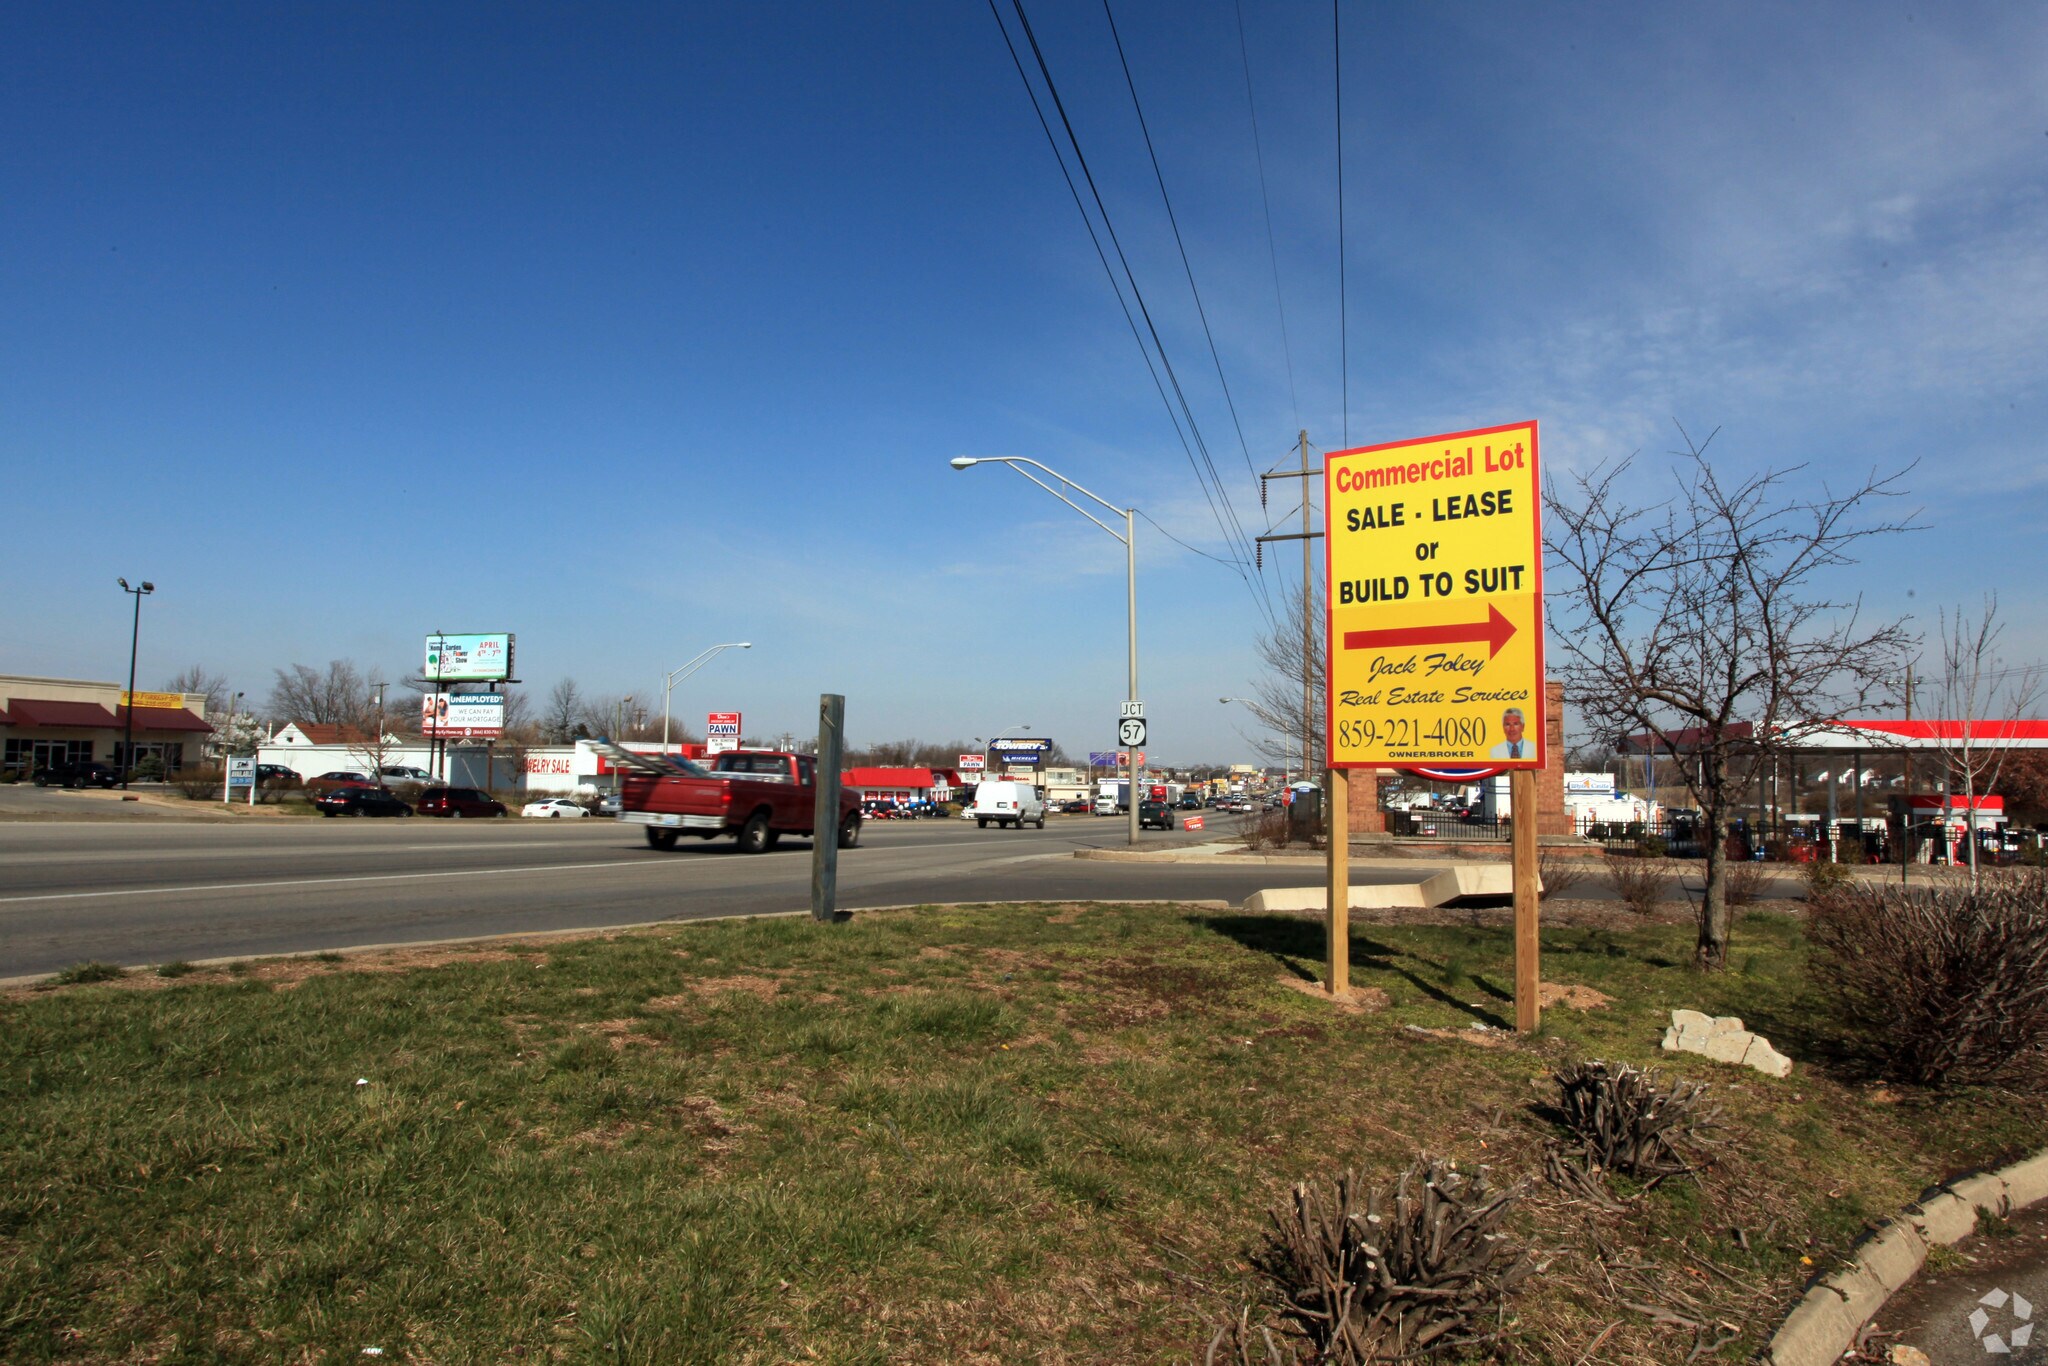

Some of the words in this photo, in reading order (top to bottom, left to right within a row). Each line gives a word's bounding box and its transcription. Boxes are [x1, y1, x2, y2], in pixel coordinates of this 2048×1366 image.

[1336, 447, 1473, 493] Commercial
[1485, 442, 1524, 473] Lot
[1347, 502, 1405, 532] SALE
[1433, 489, 1513, 522] LEASE
[1415, 541, 1439, 561] or
[1340, 576, 1409, 604] BUILD
[1419, 571, 1453, 598] TO
[1464, 564, 1525, 594] SUIT
[479, 641, 499, 649] APRIL
[1367, 655, 1417, 684] Jack
[1423, 653, 1485, 678] Foley
[450, 695, 504, 704] UNEMPLOYED?
[1339, 690, 1382, 708] Real
[1386, 687, 1445, 706] Estate
[1450, 686, 1530, 704] Services
[1122, 703, 1143, 716] JCT
[709, 724, 737, 733] PAWN
[1123, 724, 1141, 740] 57
[1338, 716, 1487, 749] 859-221-4080
[1388, 751, 1475, 759] OWNER/BROKER
[551, 758, 571, 773] SALE
